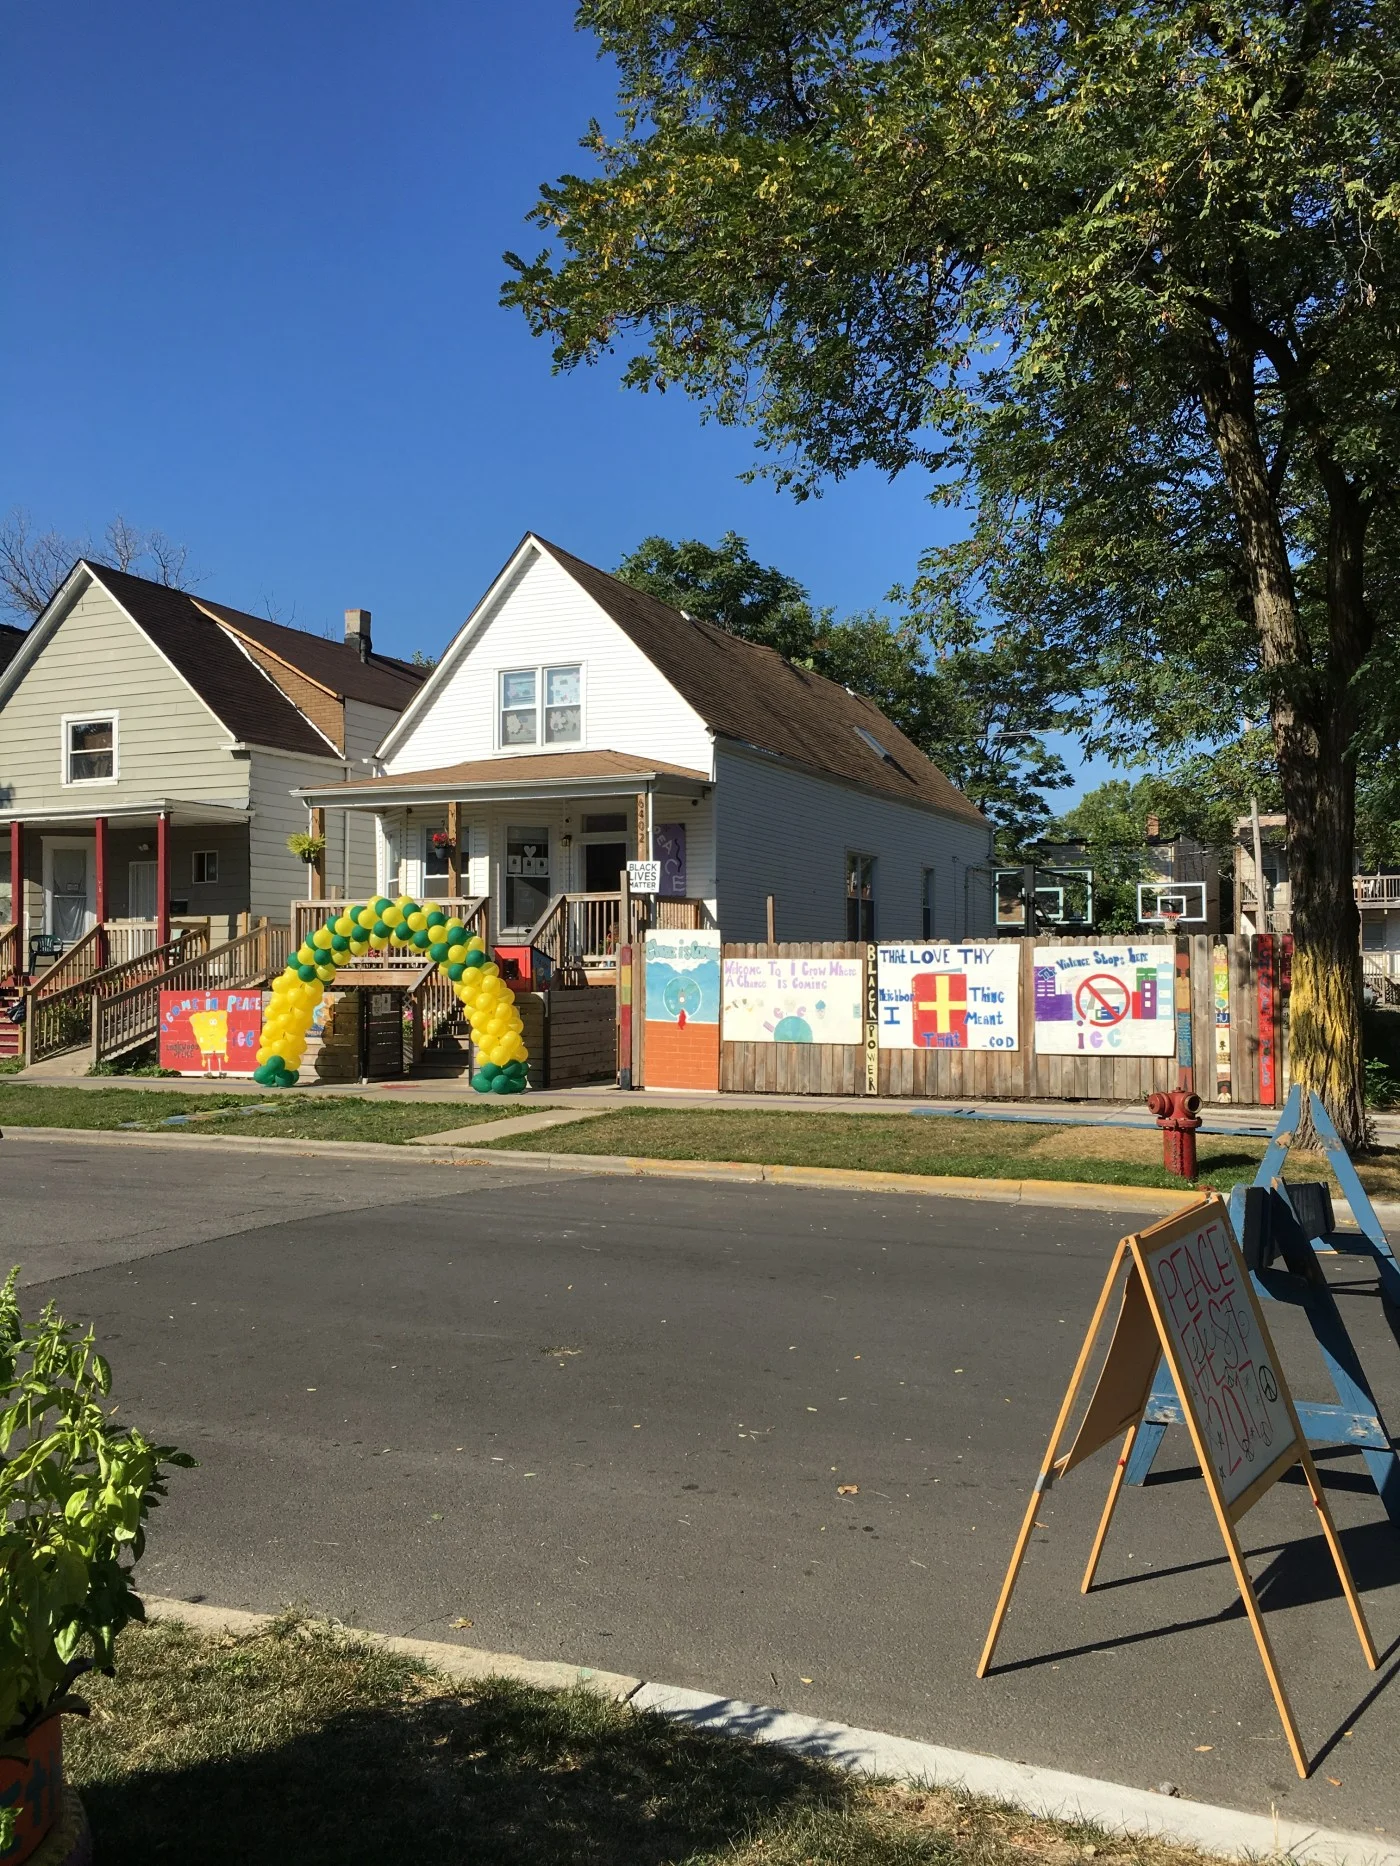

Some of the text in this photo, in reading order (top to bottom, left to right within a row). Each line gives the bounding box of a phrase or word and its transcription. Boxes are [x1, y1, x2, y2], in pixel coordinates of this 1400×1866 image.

[630, 872, 656, 880] LIVES
[911, 949, 950, 964] LOVE
[958, 949, 995, 964] THY
[768, 961, 781, 977] To
[802, 962, 827, 976] Grow
[829, 962, 856, 976] Where
[725, 975, 734, 987] A
[867, 944, 877, 1019] BLACK
[227, 995, 261, 1012] PEACE
[884, 1007, 900, 1024] I
[867, 1025, 876, 1091] POWER
[1158, 1225, 1235, 1328] PEACE
[1181, 1290, 1248, 1404] FEST
[1206, 1360, 1274, 1476] 2017
